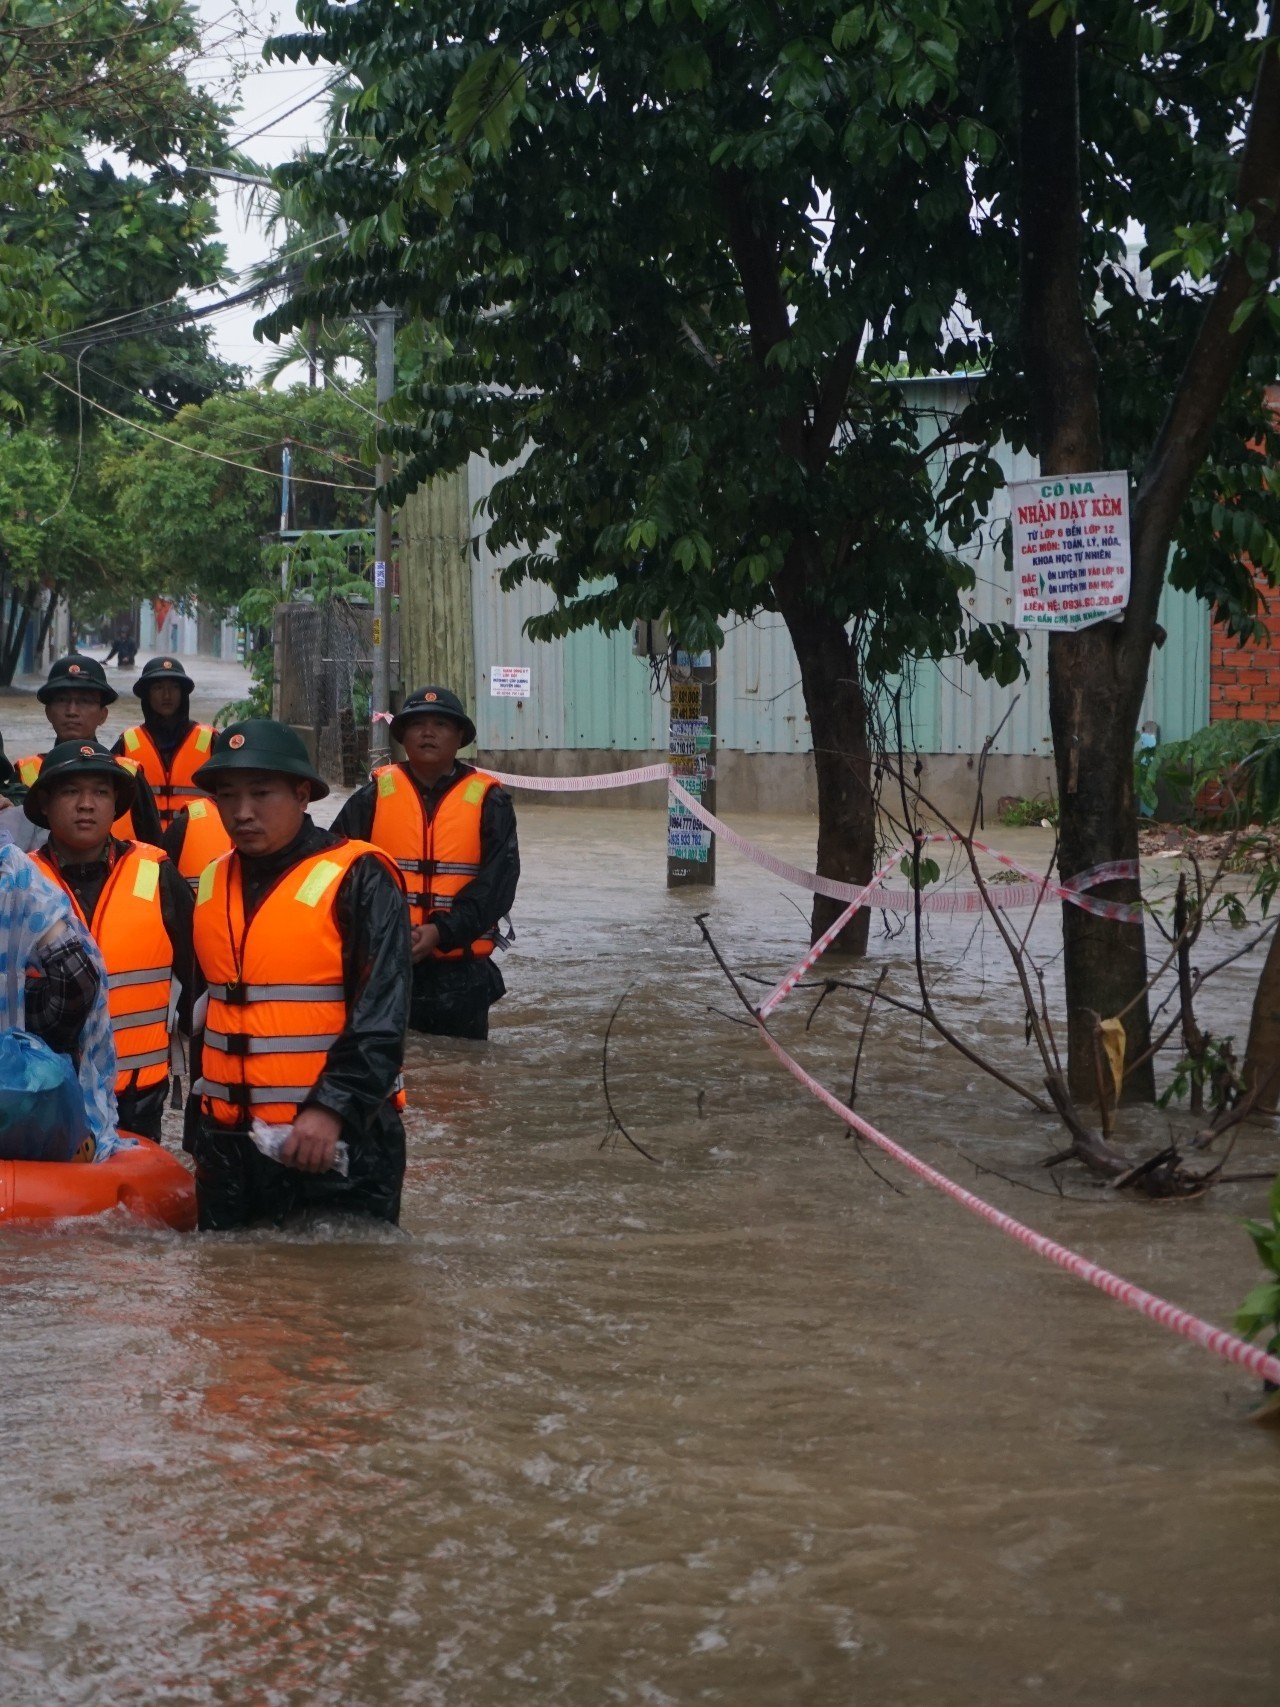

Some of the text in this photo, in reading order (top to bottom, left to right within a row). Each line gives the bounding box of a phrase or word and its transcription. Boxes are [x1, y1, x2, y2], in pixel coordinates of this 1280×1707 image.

[1041, 482, 1094, 498] CÔ NA
[1018, 493, 1122, 527] NHẬN DẠY KÈM
[1028, 530, 1038, 541] TỪ
[1040, 528, 1055, 539] LỚP
[1065, 524, 1081, 537] ĐẾN
[1084, 524, 1101, 535] LỚP
[1104, 525, 1114, 534] 12
[1022, 543, 1037, 555] CÁC
[1040, 541, 1060, 552] MÔN:
[1063, 538, 1084, 550] TOÁN,
[1032, 549, 1111, 566] KHOA HỌC TỰ NHIÊN
[1048, 565, 1124, 580] ÔN LUYỆN THI VÀO LỚP 10
[1023, 586, 1038, 598] BIỆT
[1049, 584, 1057, 594] ÔN
[1059, 582, 1078, 594] LUYỆN
[1024, 600, 1044, 611] LIÊN
[1047, 599, 1060, 613] HỆ:
